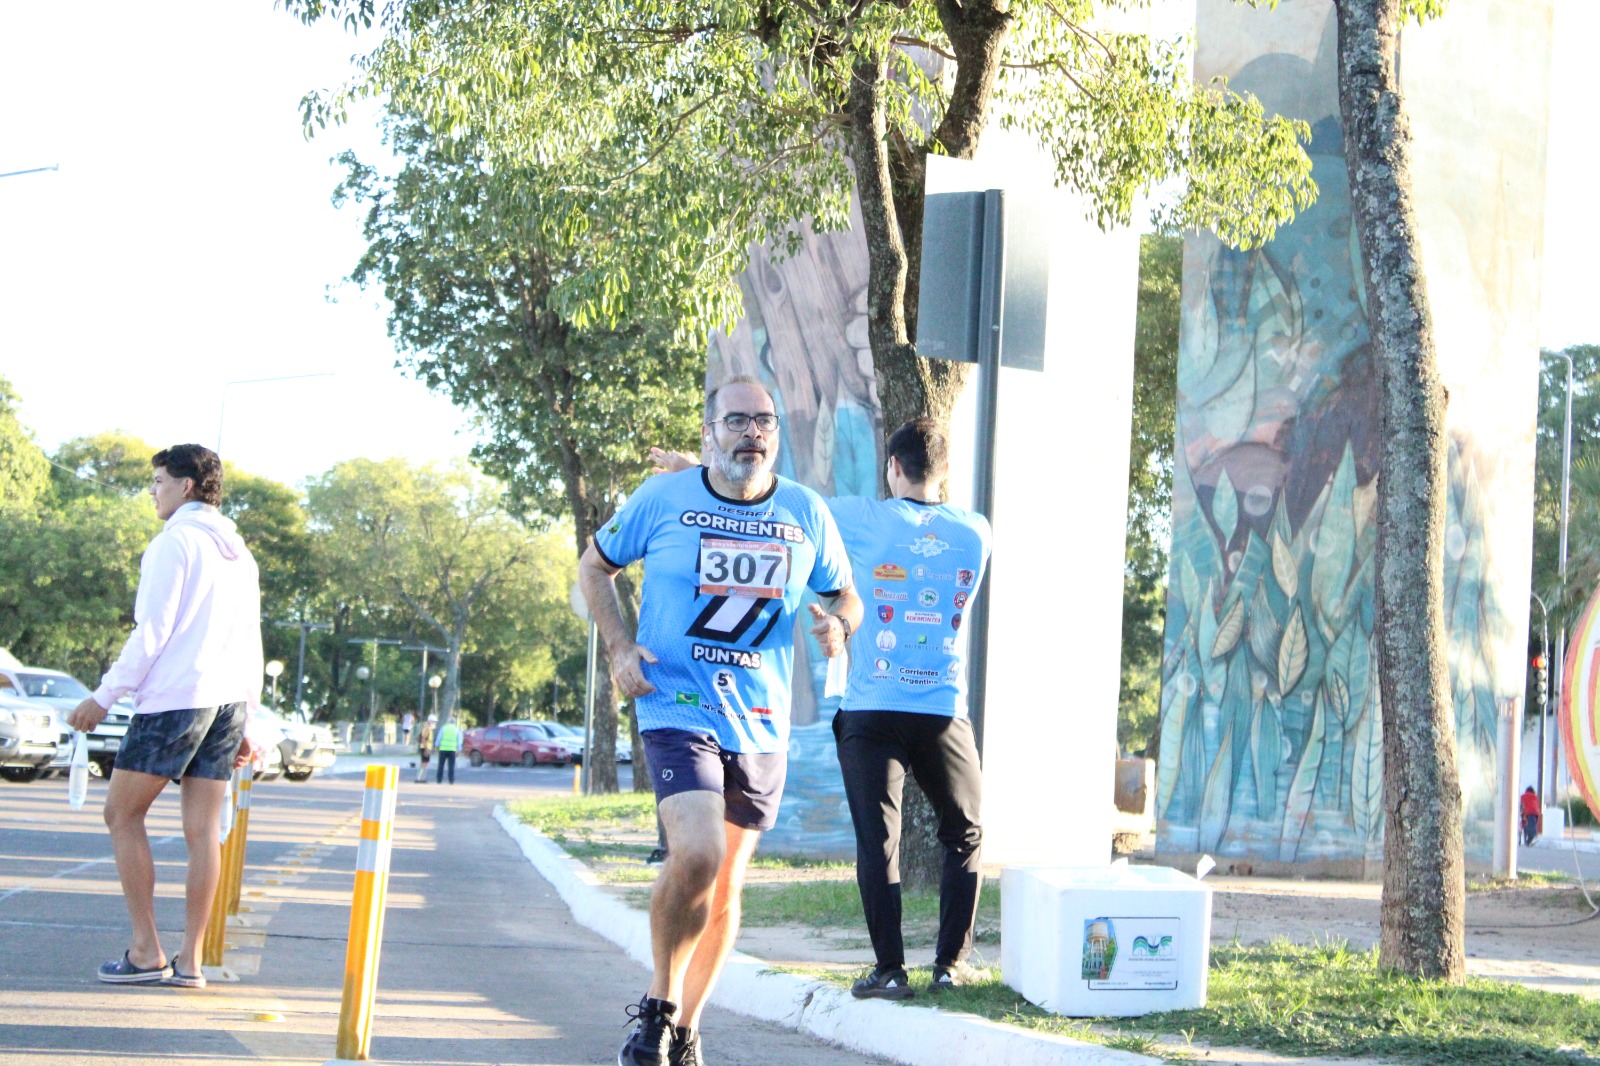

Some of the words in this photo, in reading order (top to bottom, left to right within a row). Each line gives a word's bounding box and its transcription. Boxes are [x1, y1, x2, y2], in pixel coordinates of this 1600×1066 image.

[681, 510, 805, 543] CORRIENTES
[704, 551, 783, 586] 307
[693, 644, 761, 668] PUNTAS
[899, 667, 939, 677] Corrientes
